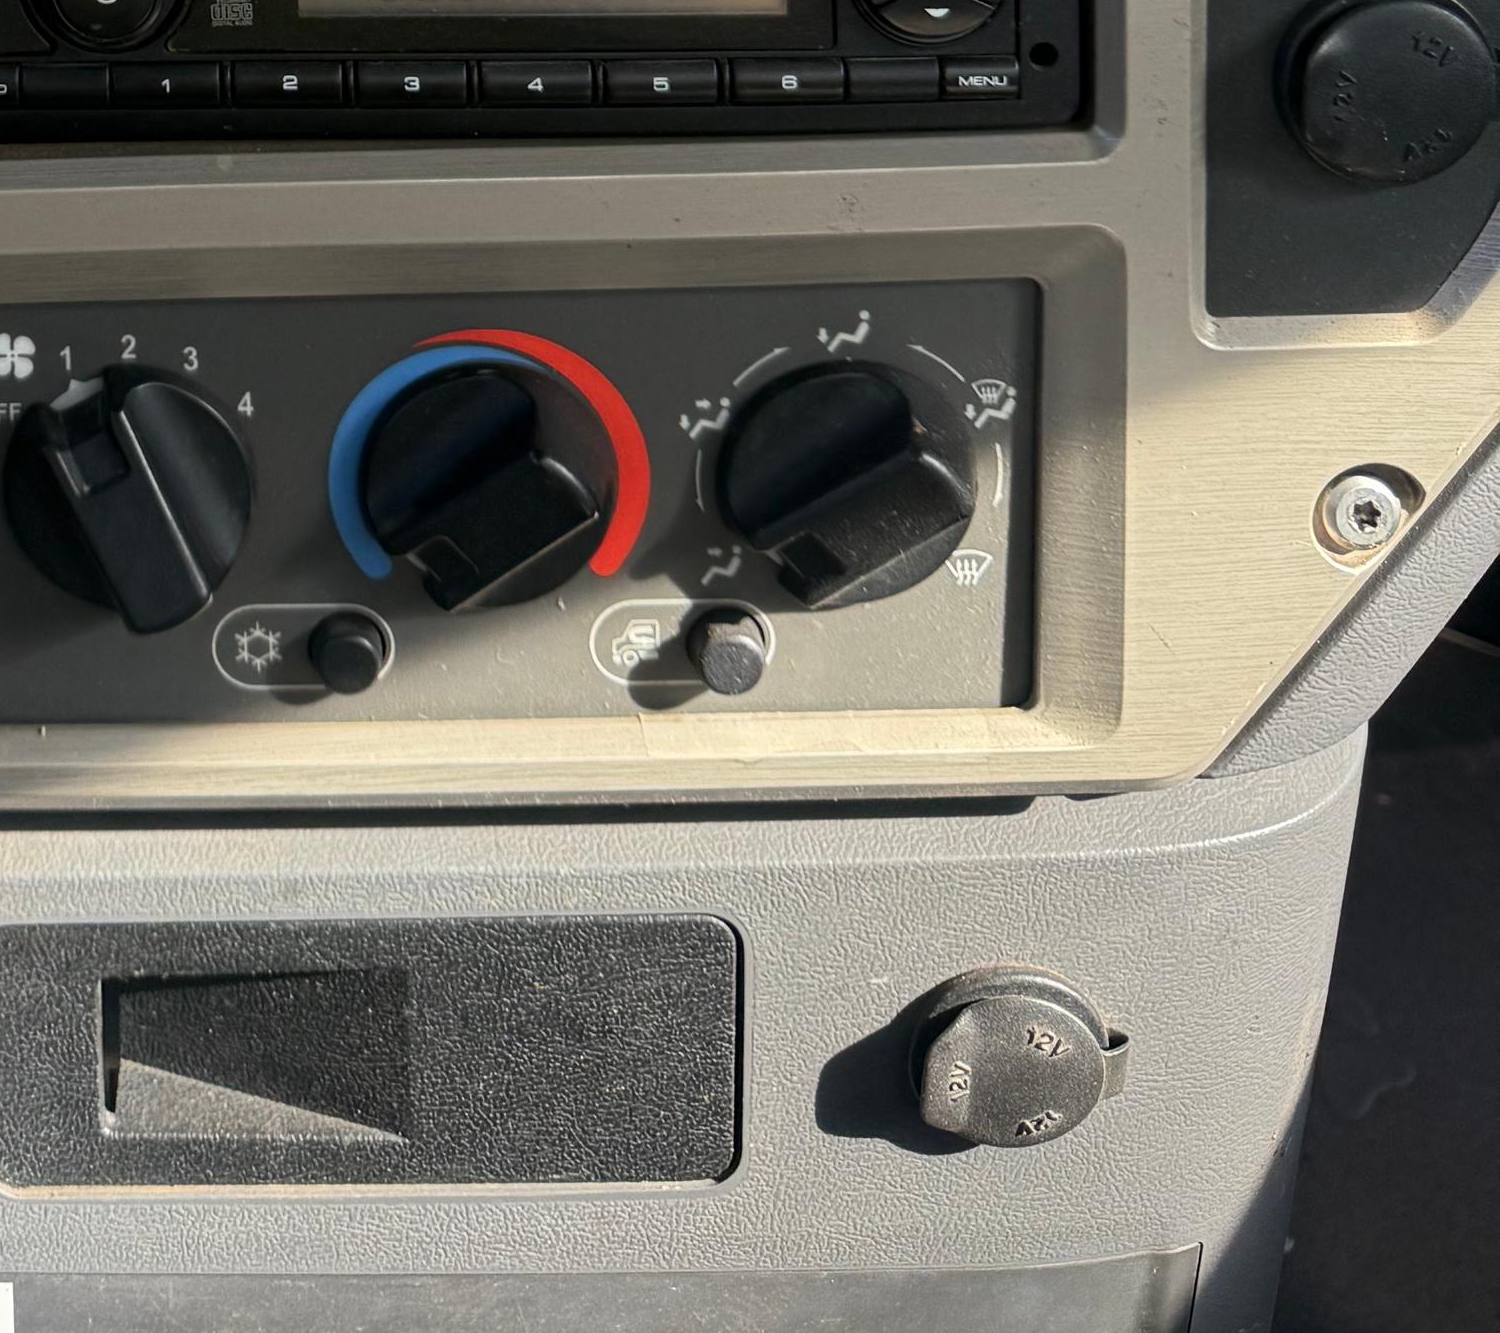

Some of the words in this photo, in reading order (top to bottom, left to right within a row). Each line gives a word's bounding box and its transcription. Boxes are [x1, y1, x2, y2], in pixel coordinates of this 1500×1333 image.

[161, 79, 172, 93] 1
[282, 75, 299, 92] 2
[403, 76, 420, 92] 3
[527, 76, 544, 92] 4
[653, 76, 669, 92] 5
[781, 75, 798, 90] 6
[957, 75, 1007, 87] MENU
[120, 334, 137, 359] 2
[59, 345, 71, 370] 1
[183, 346, 199, 371] 3
[237, 391, 254, 417] 4
[1026, 1025, 1072, 1058] 12V
[948, 1061, 972, 1101] 12V
